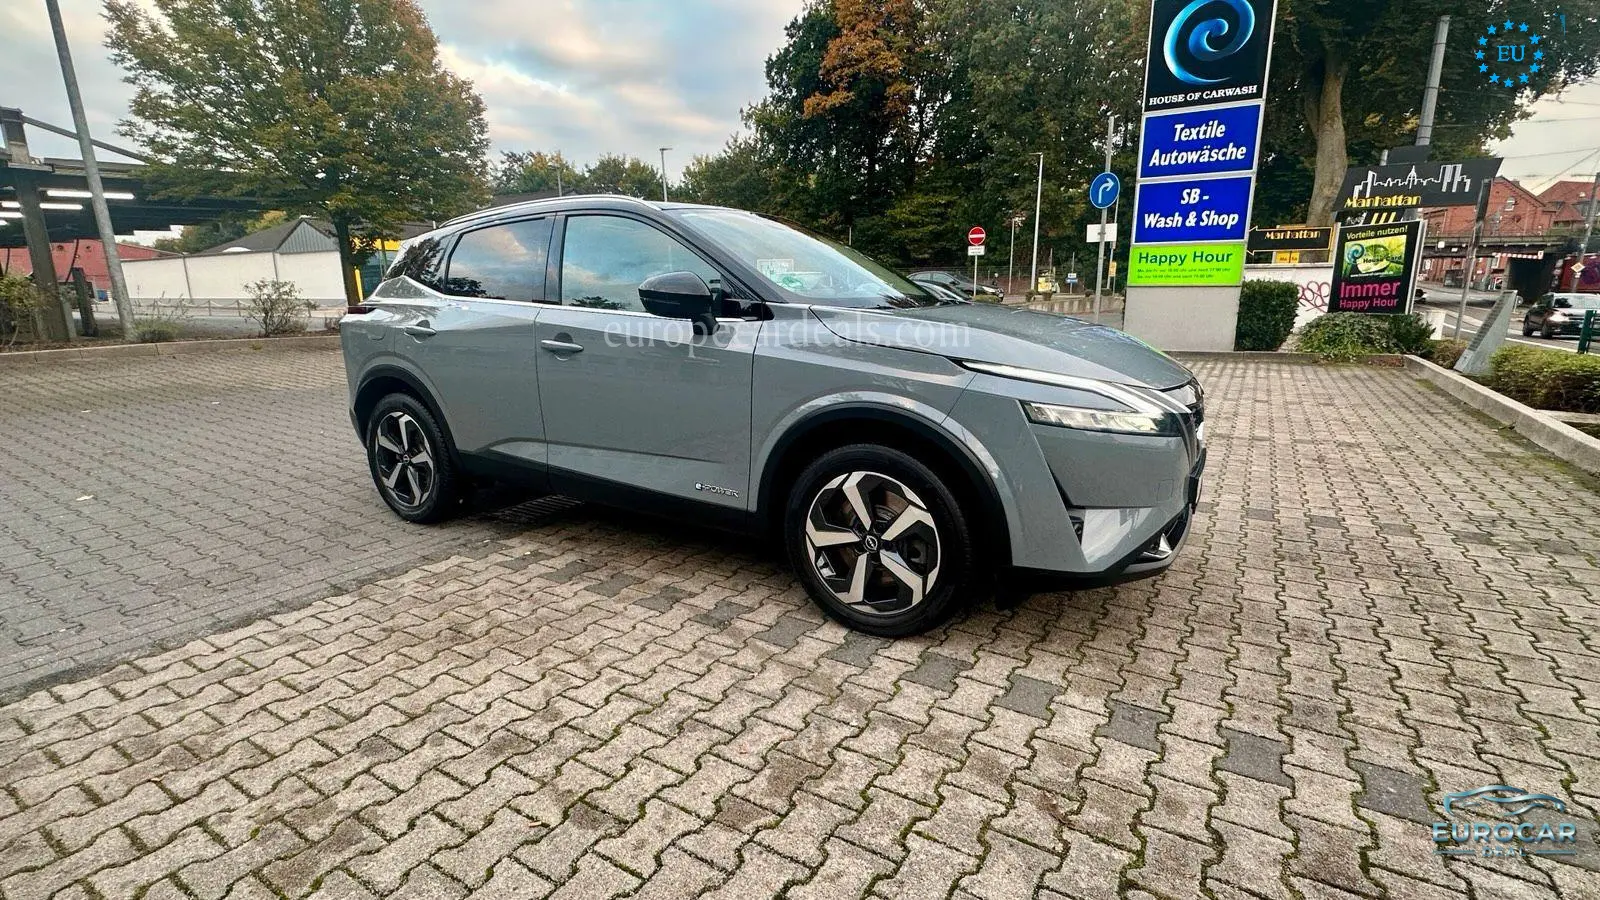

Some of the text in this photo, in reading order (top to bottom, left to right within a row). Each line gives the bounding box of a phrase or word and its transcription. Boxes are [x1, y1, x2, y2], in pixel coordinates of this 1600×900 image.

[1149, 85, 1258, 106] HOUSE OF CARWASH
[1173, 120, 1226, 141] Textile
[1149, 142, 1246, 167] Autowäsche
[1344, 194, 1422, 208] Manhattan
[1144, 210, 1239, 229] Wash & Shop
[1265, 230, 1320, 240] Manhattan
[1346, 225, 1408, 240] Vorteile nutzen!
[1138, 251, 1233, 266] Happy Hour
[1340, 281, 1401, 298] Immer
[1339, 297, 1399, 310] Happy Hour
